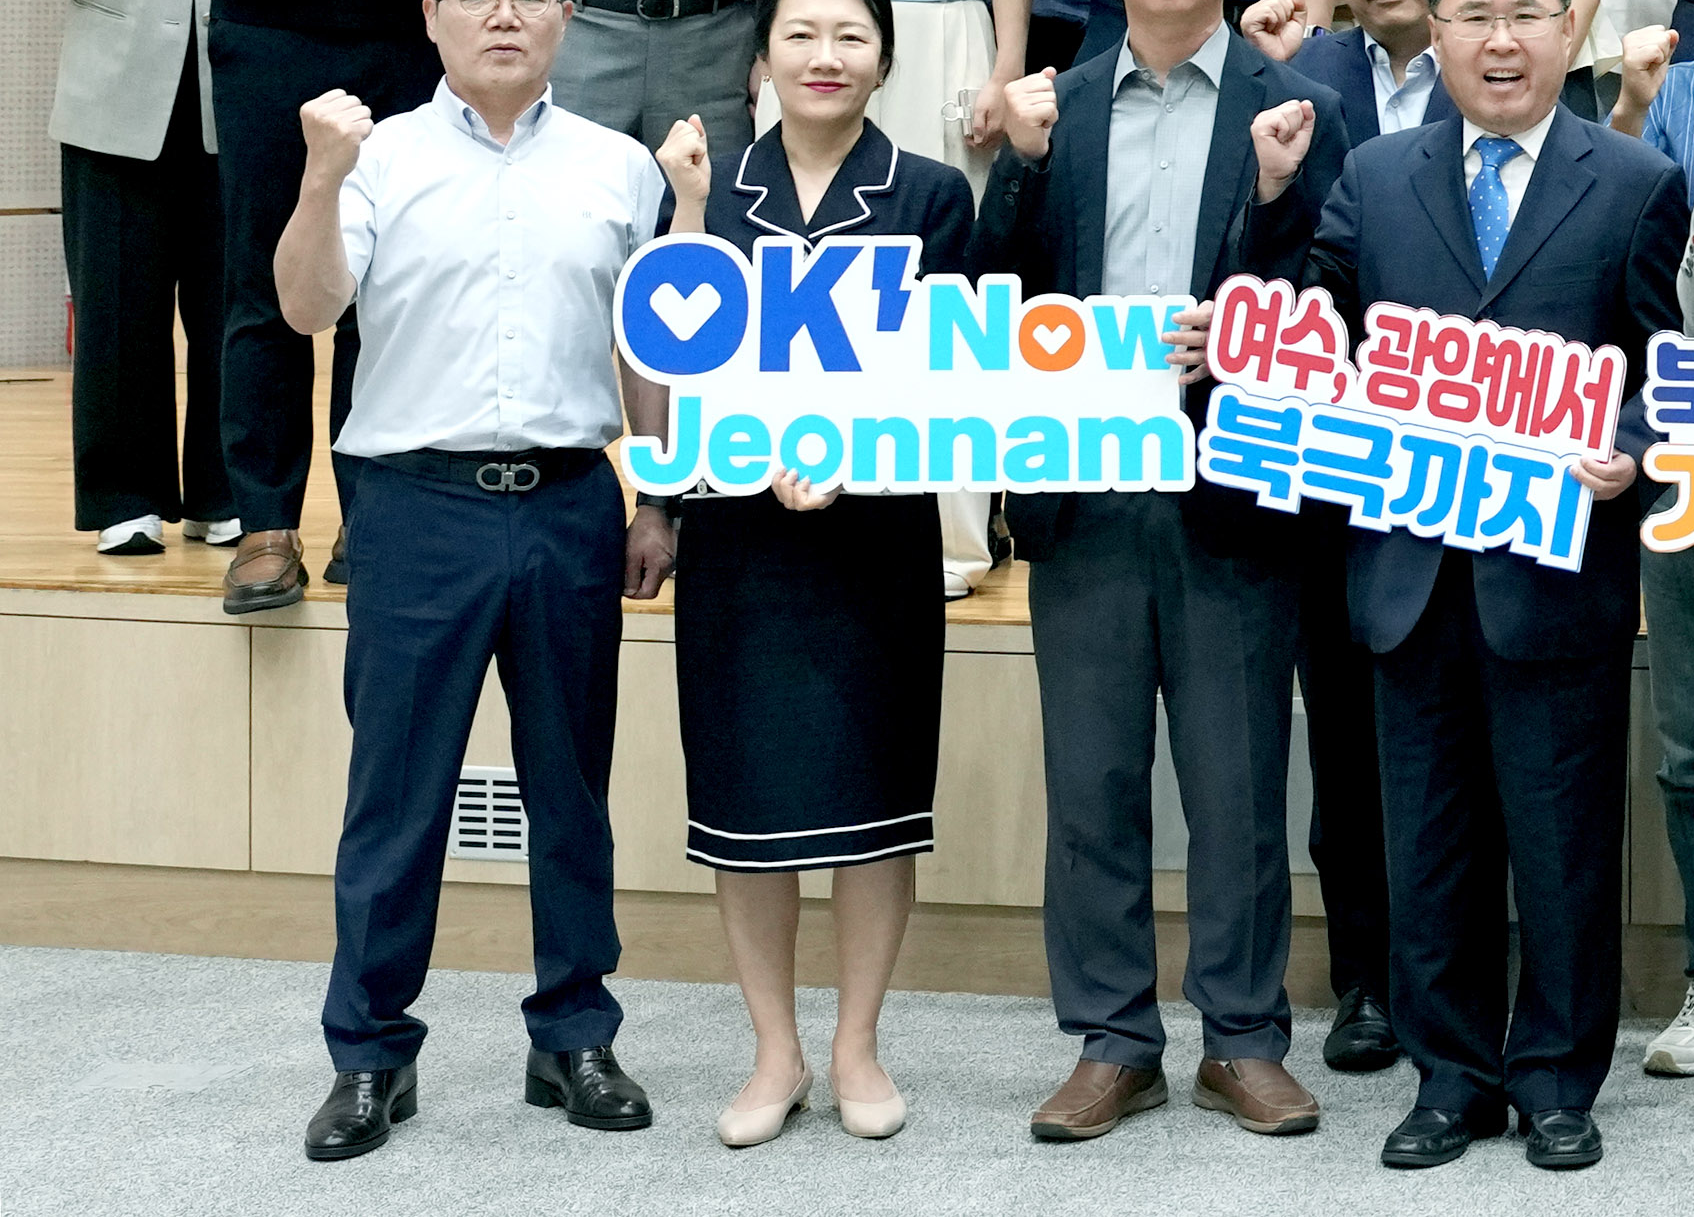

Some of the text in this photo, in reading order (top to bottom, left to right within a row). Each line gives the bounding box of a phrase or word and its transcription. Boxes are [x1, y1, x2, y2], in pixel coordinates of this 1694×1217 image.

[929, 284, 1186, 371] Now
[1217, 286, 1613, 449] 여수, 광양에서
[629, 396, 1184, 485] Jeonnam
[1209, 394, 1583, 558] 북극까지
